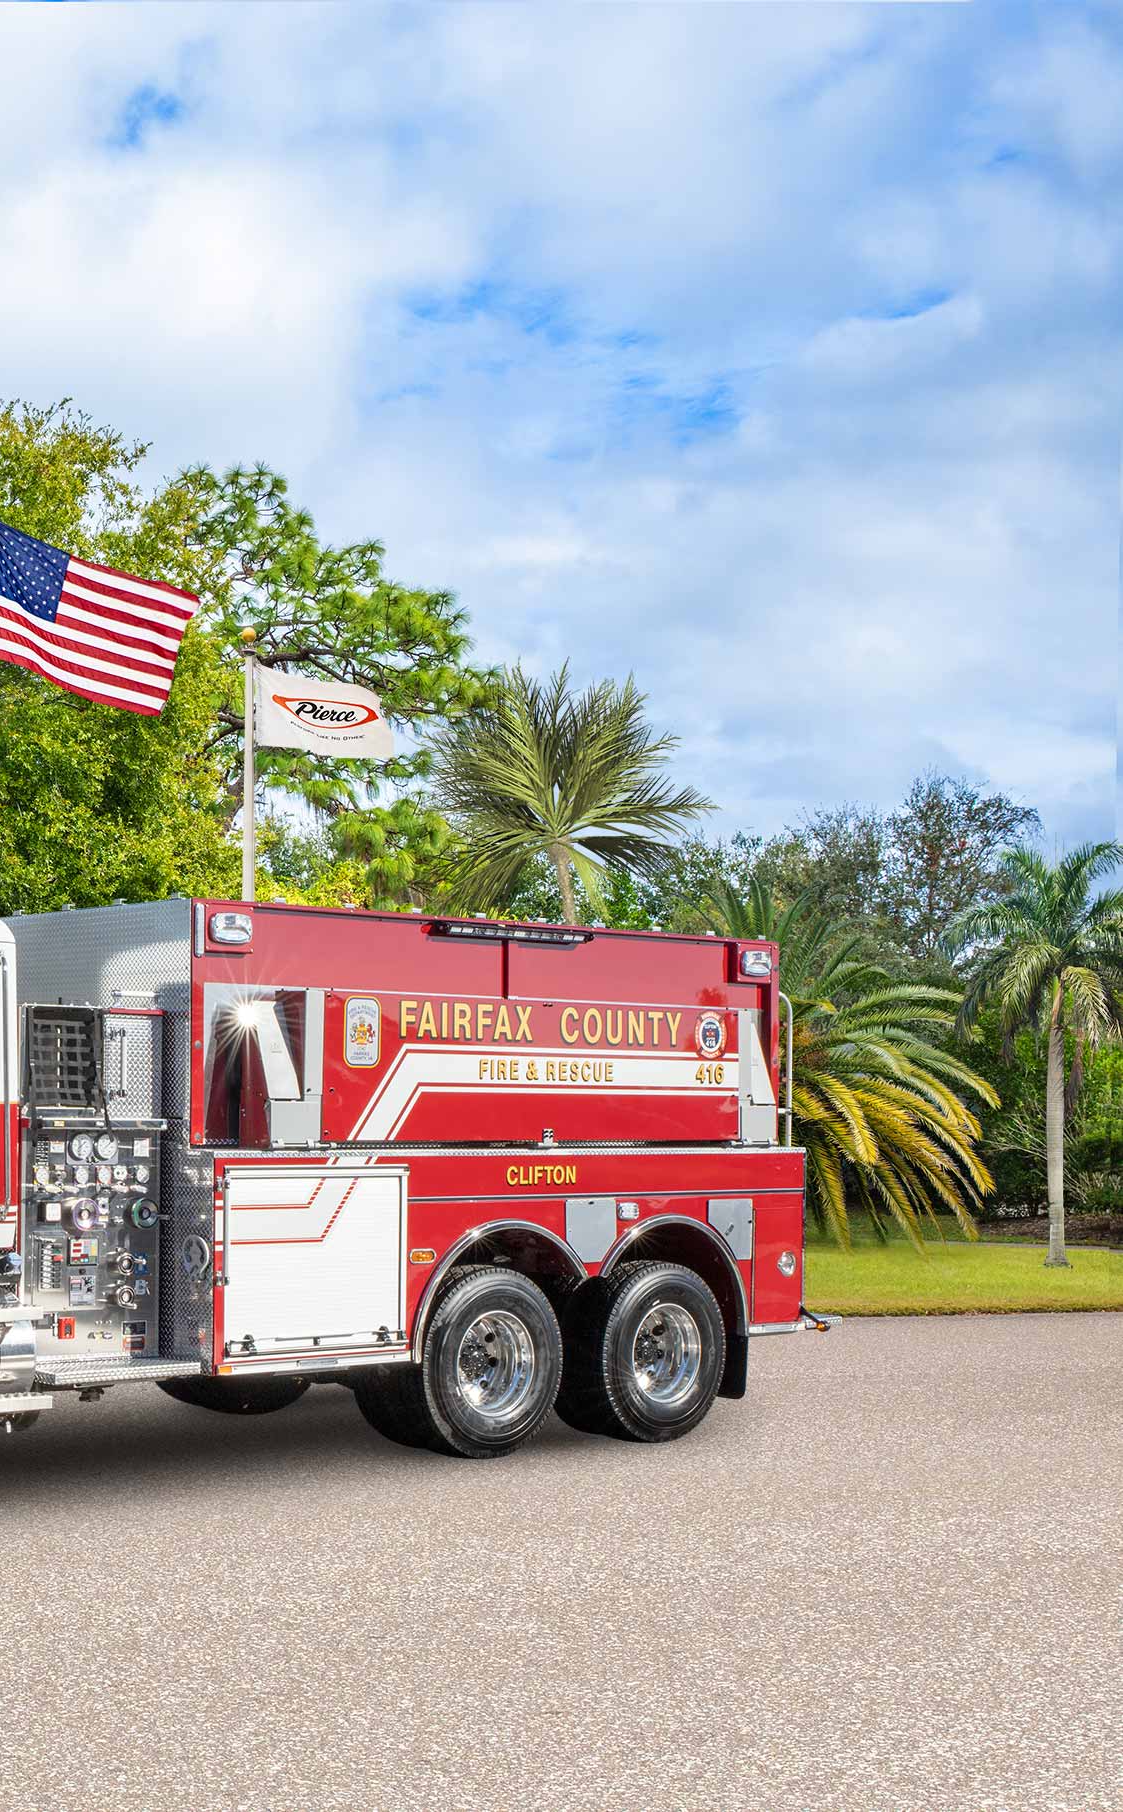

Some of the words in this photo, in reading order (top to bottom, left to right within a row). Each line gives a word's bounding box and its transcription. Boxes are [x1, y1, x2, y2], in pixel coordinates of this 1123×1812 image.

[295, 702, 356, 722] Pierce
[399, 1000, 533, 1042] FAIRFAX
[560, 1007, 682, 1047] COUNTY
[479, 1060, 519, 1080] FIRE
[526, 1060, 539, 1080] &
[546, 1061, 614, 1082] RESCUE
[695, 1063, 725, 1085] 416
[506, 1165, 576, 1187] CLIFTON
